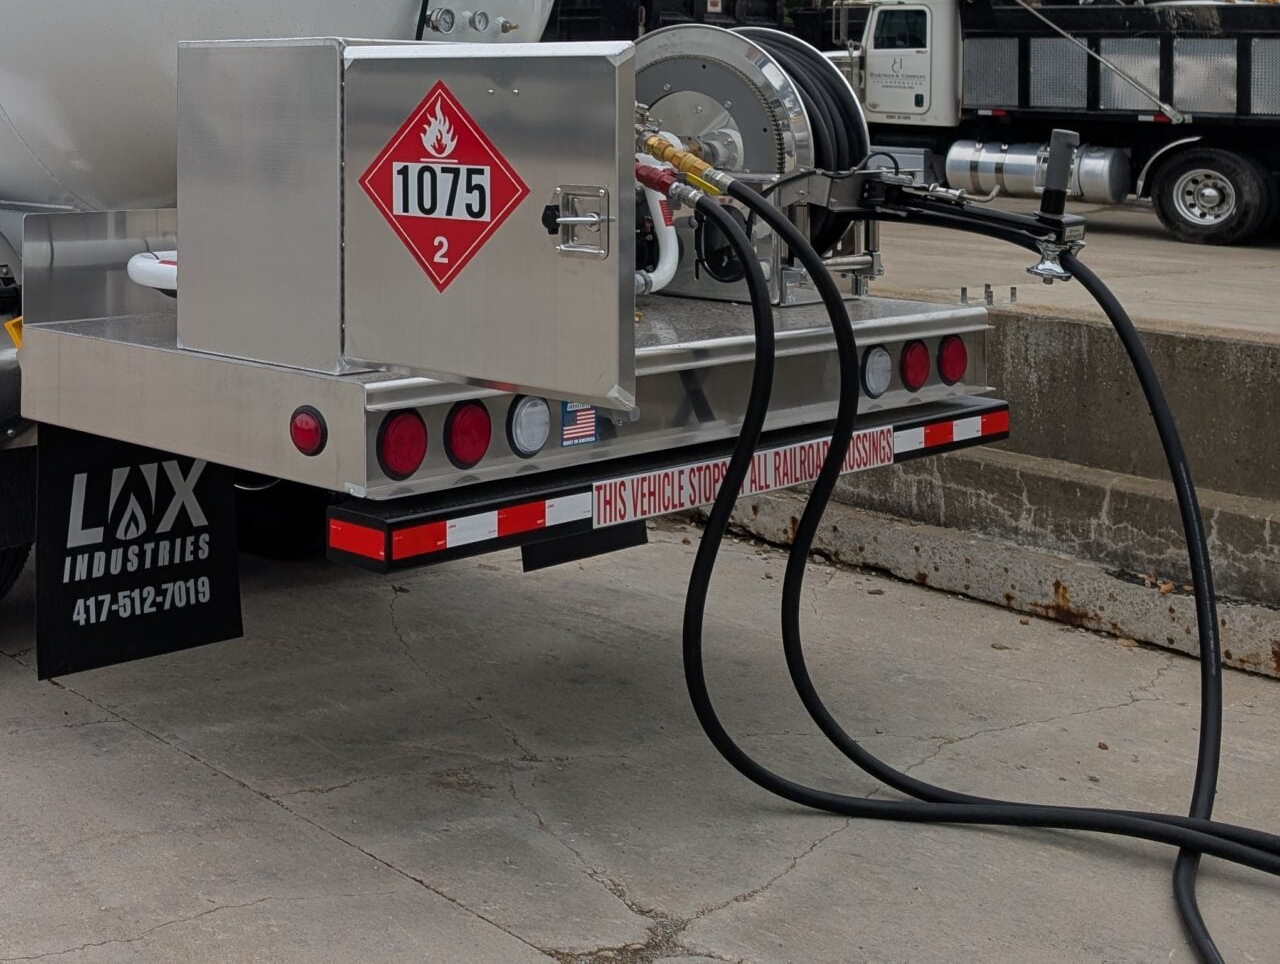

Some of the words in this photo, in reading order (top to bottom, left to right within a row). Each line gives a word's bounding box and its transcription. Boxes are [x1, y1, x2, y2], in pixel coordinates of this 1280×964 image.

[396, 164, 487, 219] 1075
[433, 236, 449, 263] 2
[595, 482, 627, 526] THIS
[631, 469, 685, 518] VEHICLE
[750, 453, 771, 493] ALL
[63, 533, 210, 584] INDUSTRIES
[72, 576, 211, 626] 417-512-7019
